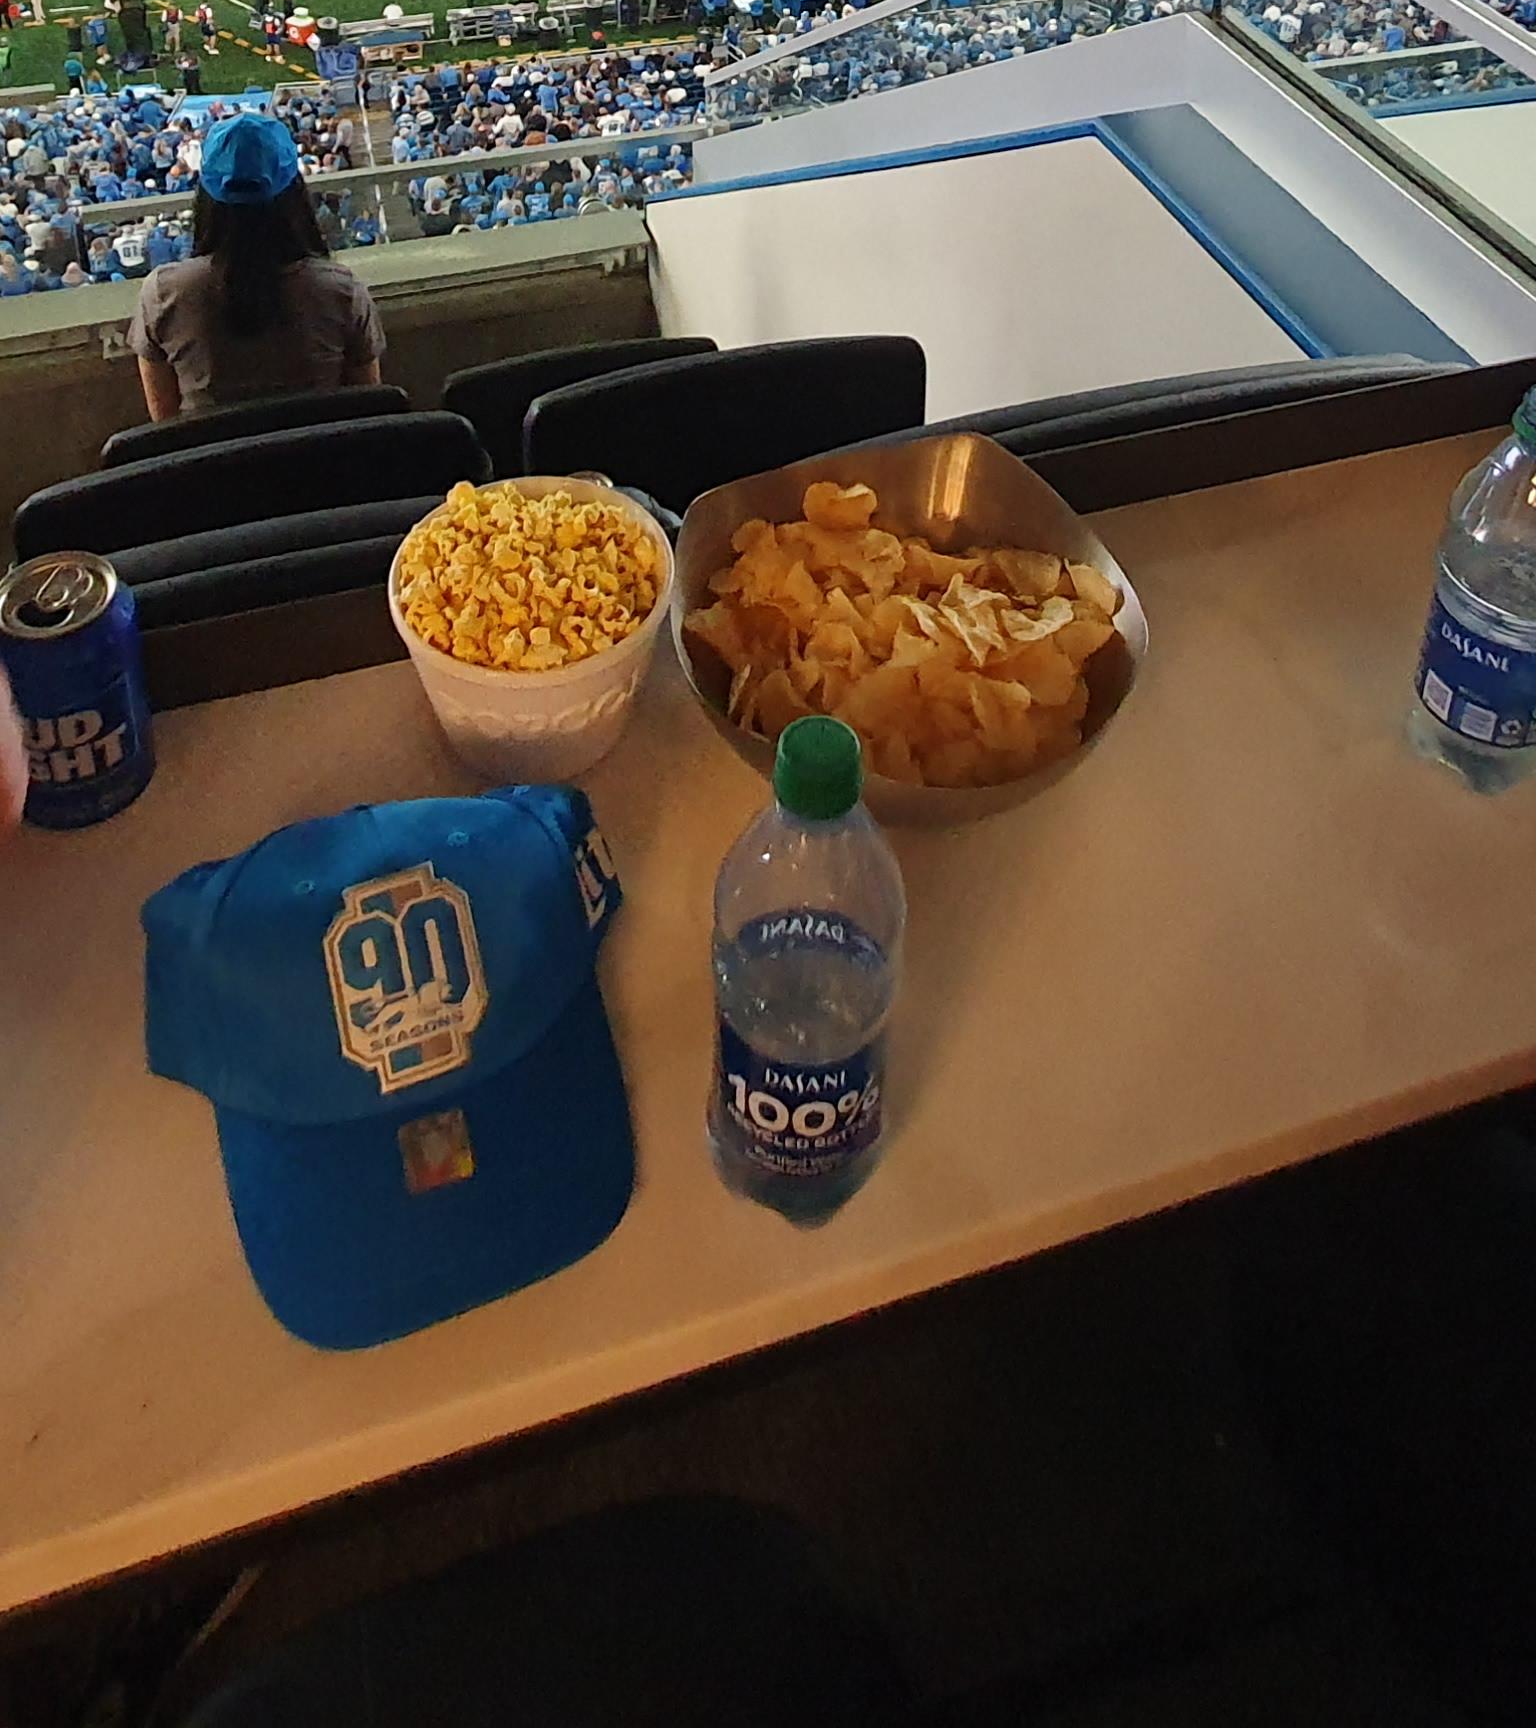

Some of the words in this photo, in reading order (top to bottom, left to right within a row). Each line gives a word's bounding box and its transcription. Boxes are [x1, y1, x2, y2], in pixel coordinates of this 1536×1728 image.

[1441, 621, 1510, 673] DASANI
[22, 709, 103, 751] UD
[337, 896, 471, 1005] 90
[369, 1008, 464, 1054] SEASONS
[727, 1072, 880, 1138] 100%
[764, 1067, 848, 1094] DASANI
